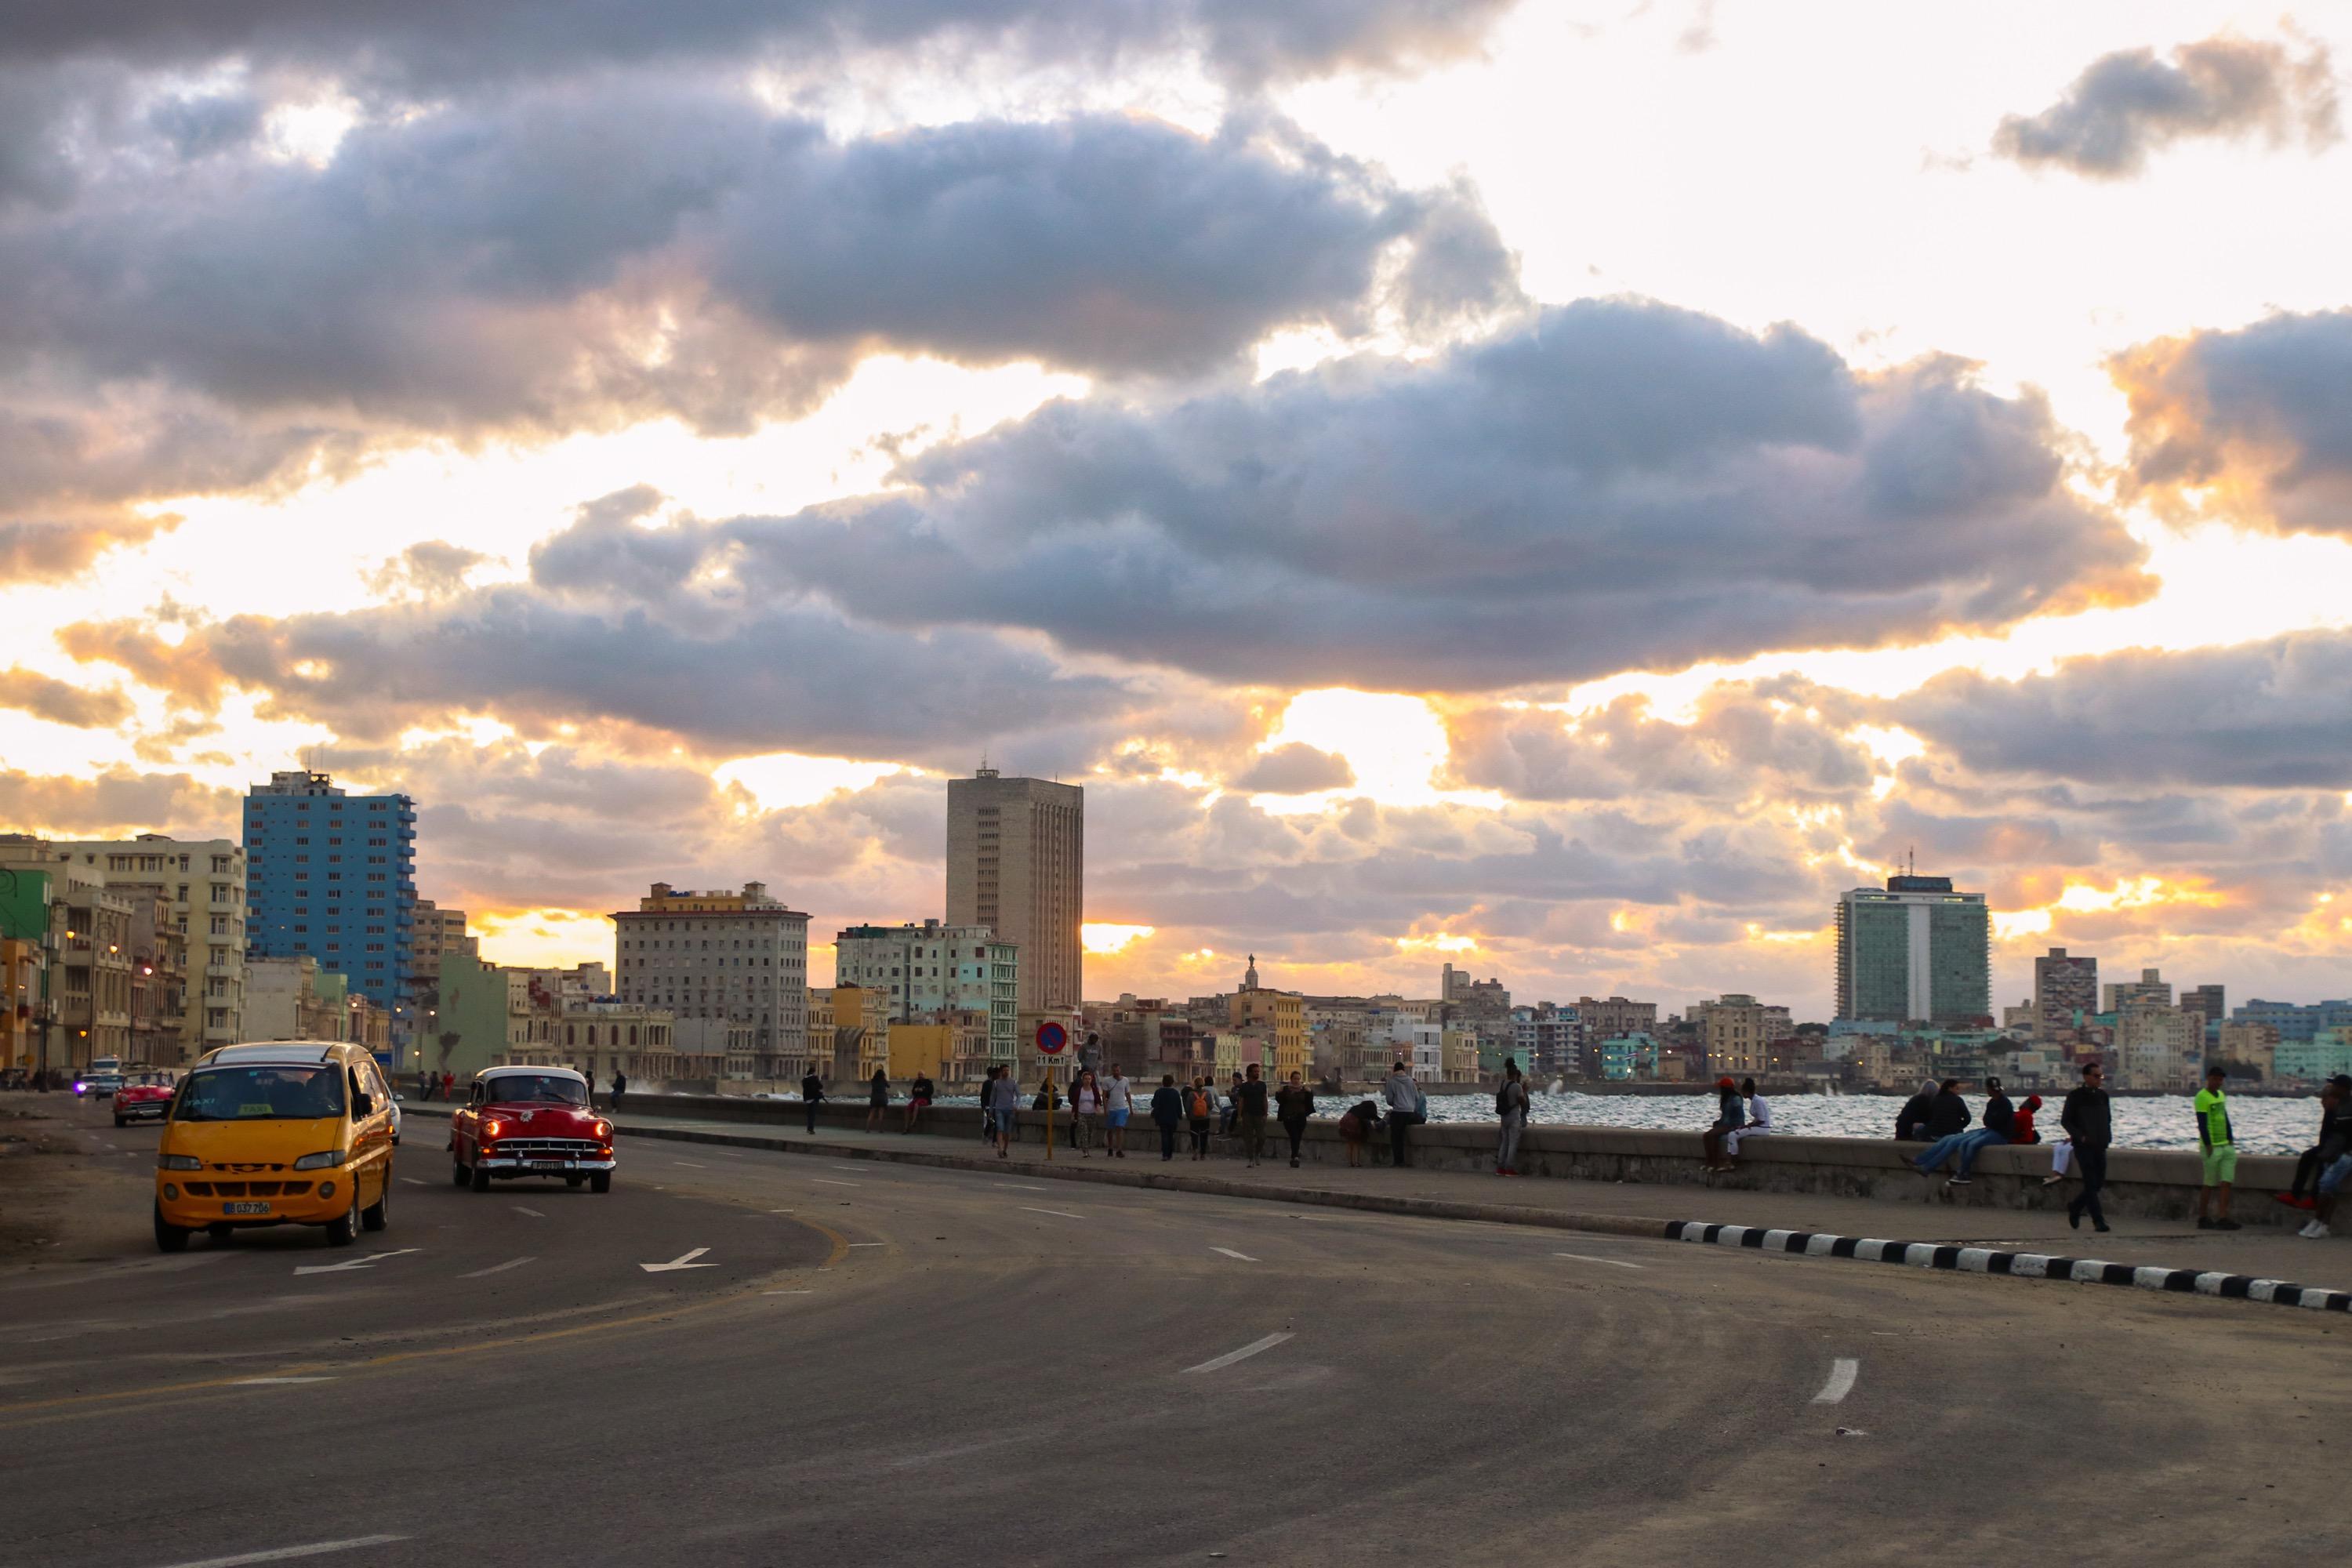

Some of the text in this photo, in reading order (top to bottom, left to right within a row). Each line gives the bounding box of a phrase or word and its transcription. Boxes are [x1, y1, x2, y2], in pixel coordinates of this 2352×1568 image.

[1042, 1056, 1060, 1065] 1 Km
[187, 1098, 216, 1107] TAXI
[237, 1203, 252, 1213] 037
[253, 1203, 269, 1213] 706
